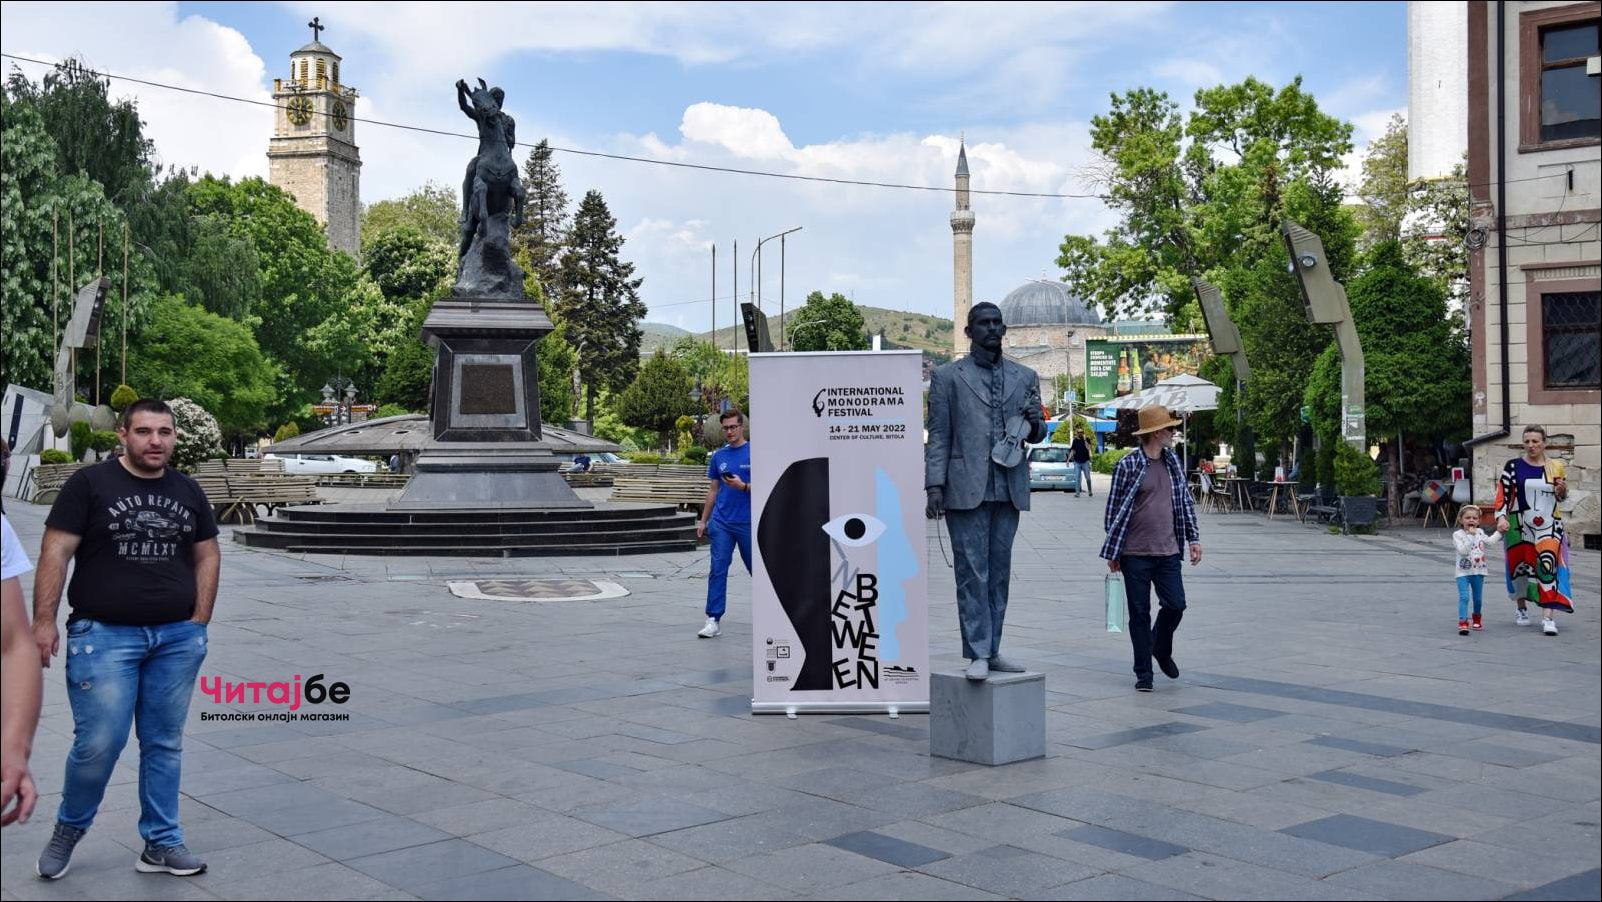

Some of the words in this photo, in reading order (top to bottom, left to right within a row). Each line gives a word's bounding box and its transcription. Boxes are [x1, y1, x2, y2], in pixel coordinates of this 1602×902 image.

[827, 387, 904, 396] INTERNATIONAL
[827, 397, 904, 407] MONODRAMA
[828, 408, 873, 416] FESTIVAL
[829, 425, 841, 433] 14
[883, 424, 906, 432] 2022
[108, 495, 142, 517] AUTO
[148, 494, 190, 520] REPAIR
